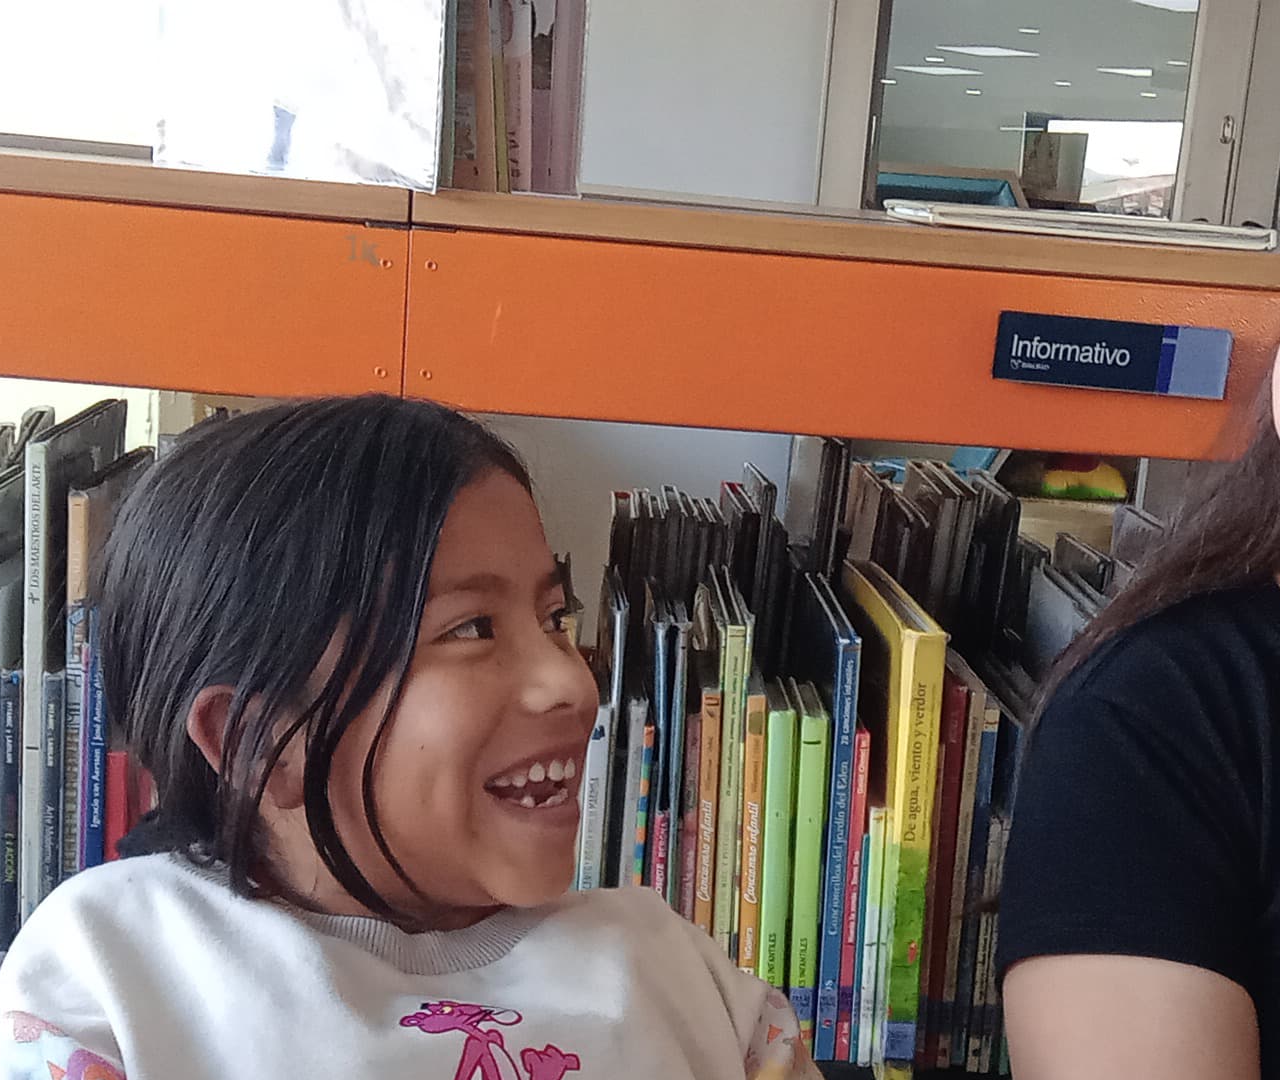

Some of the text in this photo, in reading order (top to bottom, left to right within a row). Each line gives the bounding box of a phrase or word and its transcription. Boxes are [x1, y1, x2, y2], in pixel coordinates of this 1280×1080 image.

[1011, 333, 1131, 367] Informativo
[30, 462, 41, 588] LOS MAESTROS DEL ARTE
[842, 659, 854, 696] infantiles
[93, 724, 102, 740] José
[841, 696, 853, 735] canciones
[903, 682, 928, 842] De agua, viento y verdor
[45, 805, 54, 824] Arte
[90, 799, 100, 827] Ignacio
[834, 791, 848, 809] del
[700, 800, 714, 841] infantil
[746, 802, 761, 843] infantil
[833, 810, 848, 846] jardín
[4, 846, 14, 882] ACCIÓN
[696, 843, 712, 901] Cancionero
[831, 846, 845, 863] del
[744, 845, 760, 904] Cancionero
[768, 933, 777, 975] INFANTILES
[799, 938, 808, 977] INFANTILES
